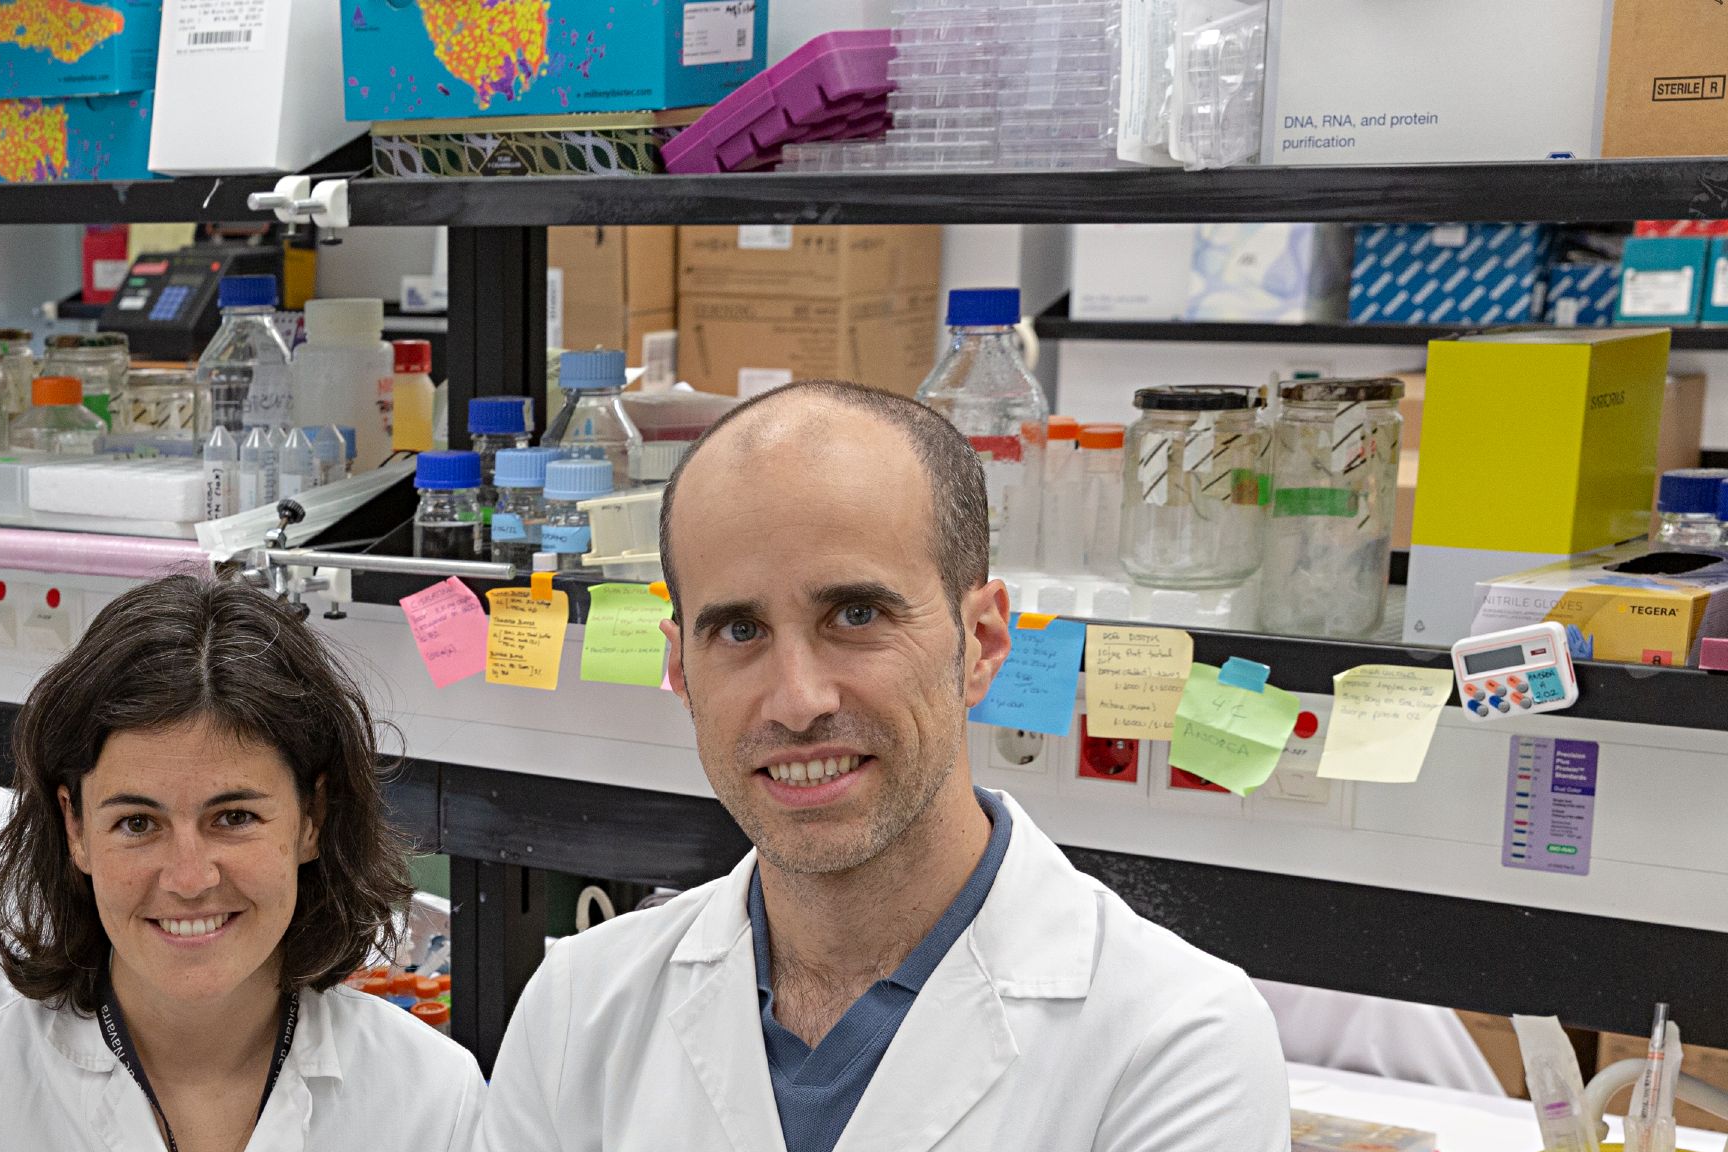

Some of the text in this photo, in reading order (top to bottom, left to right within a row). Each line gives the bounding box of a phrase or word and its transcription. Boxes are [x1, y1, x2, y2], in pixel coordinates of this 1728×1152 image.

[1657, 82, 1701, 95] STERILE
[1710, 81, 1718, 93] R
[1284, 112, 1439, 128] DNA, RNA, and protein
[1282, 135, 1356, 151] purification
[1484, 595, 1583, 611] NITRILE GLOVES
[1630, 605, 1676, 617] TEGERA
